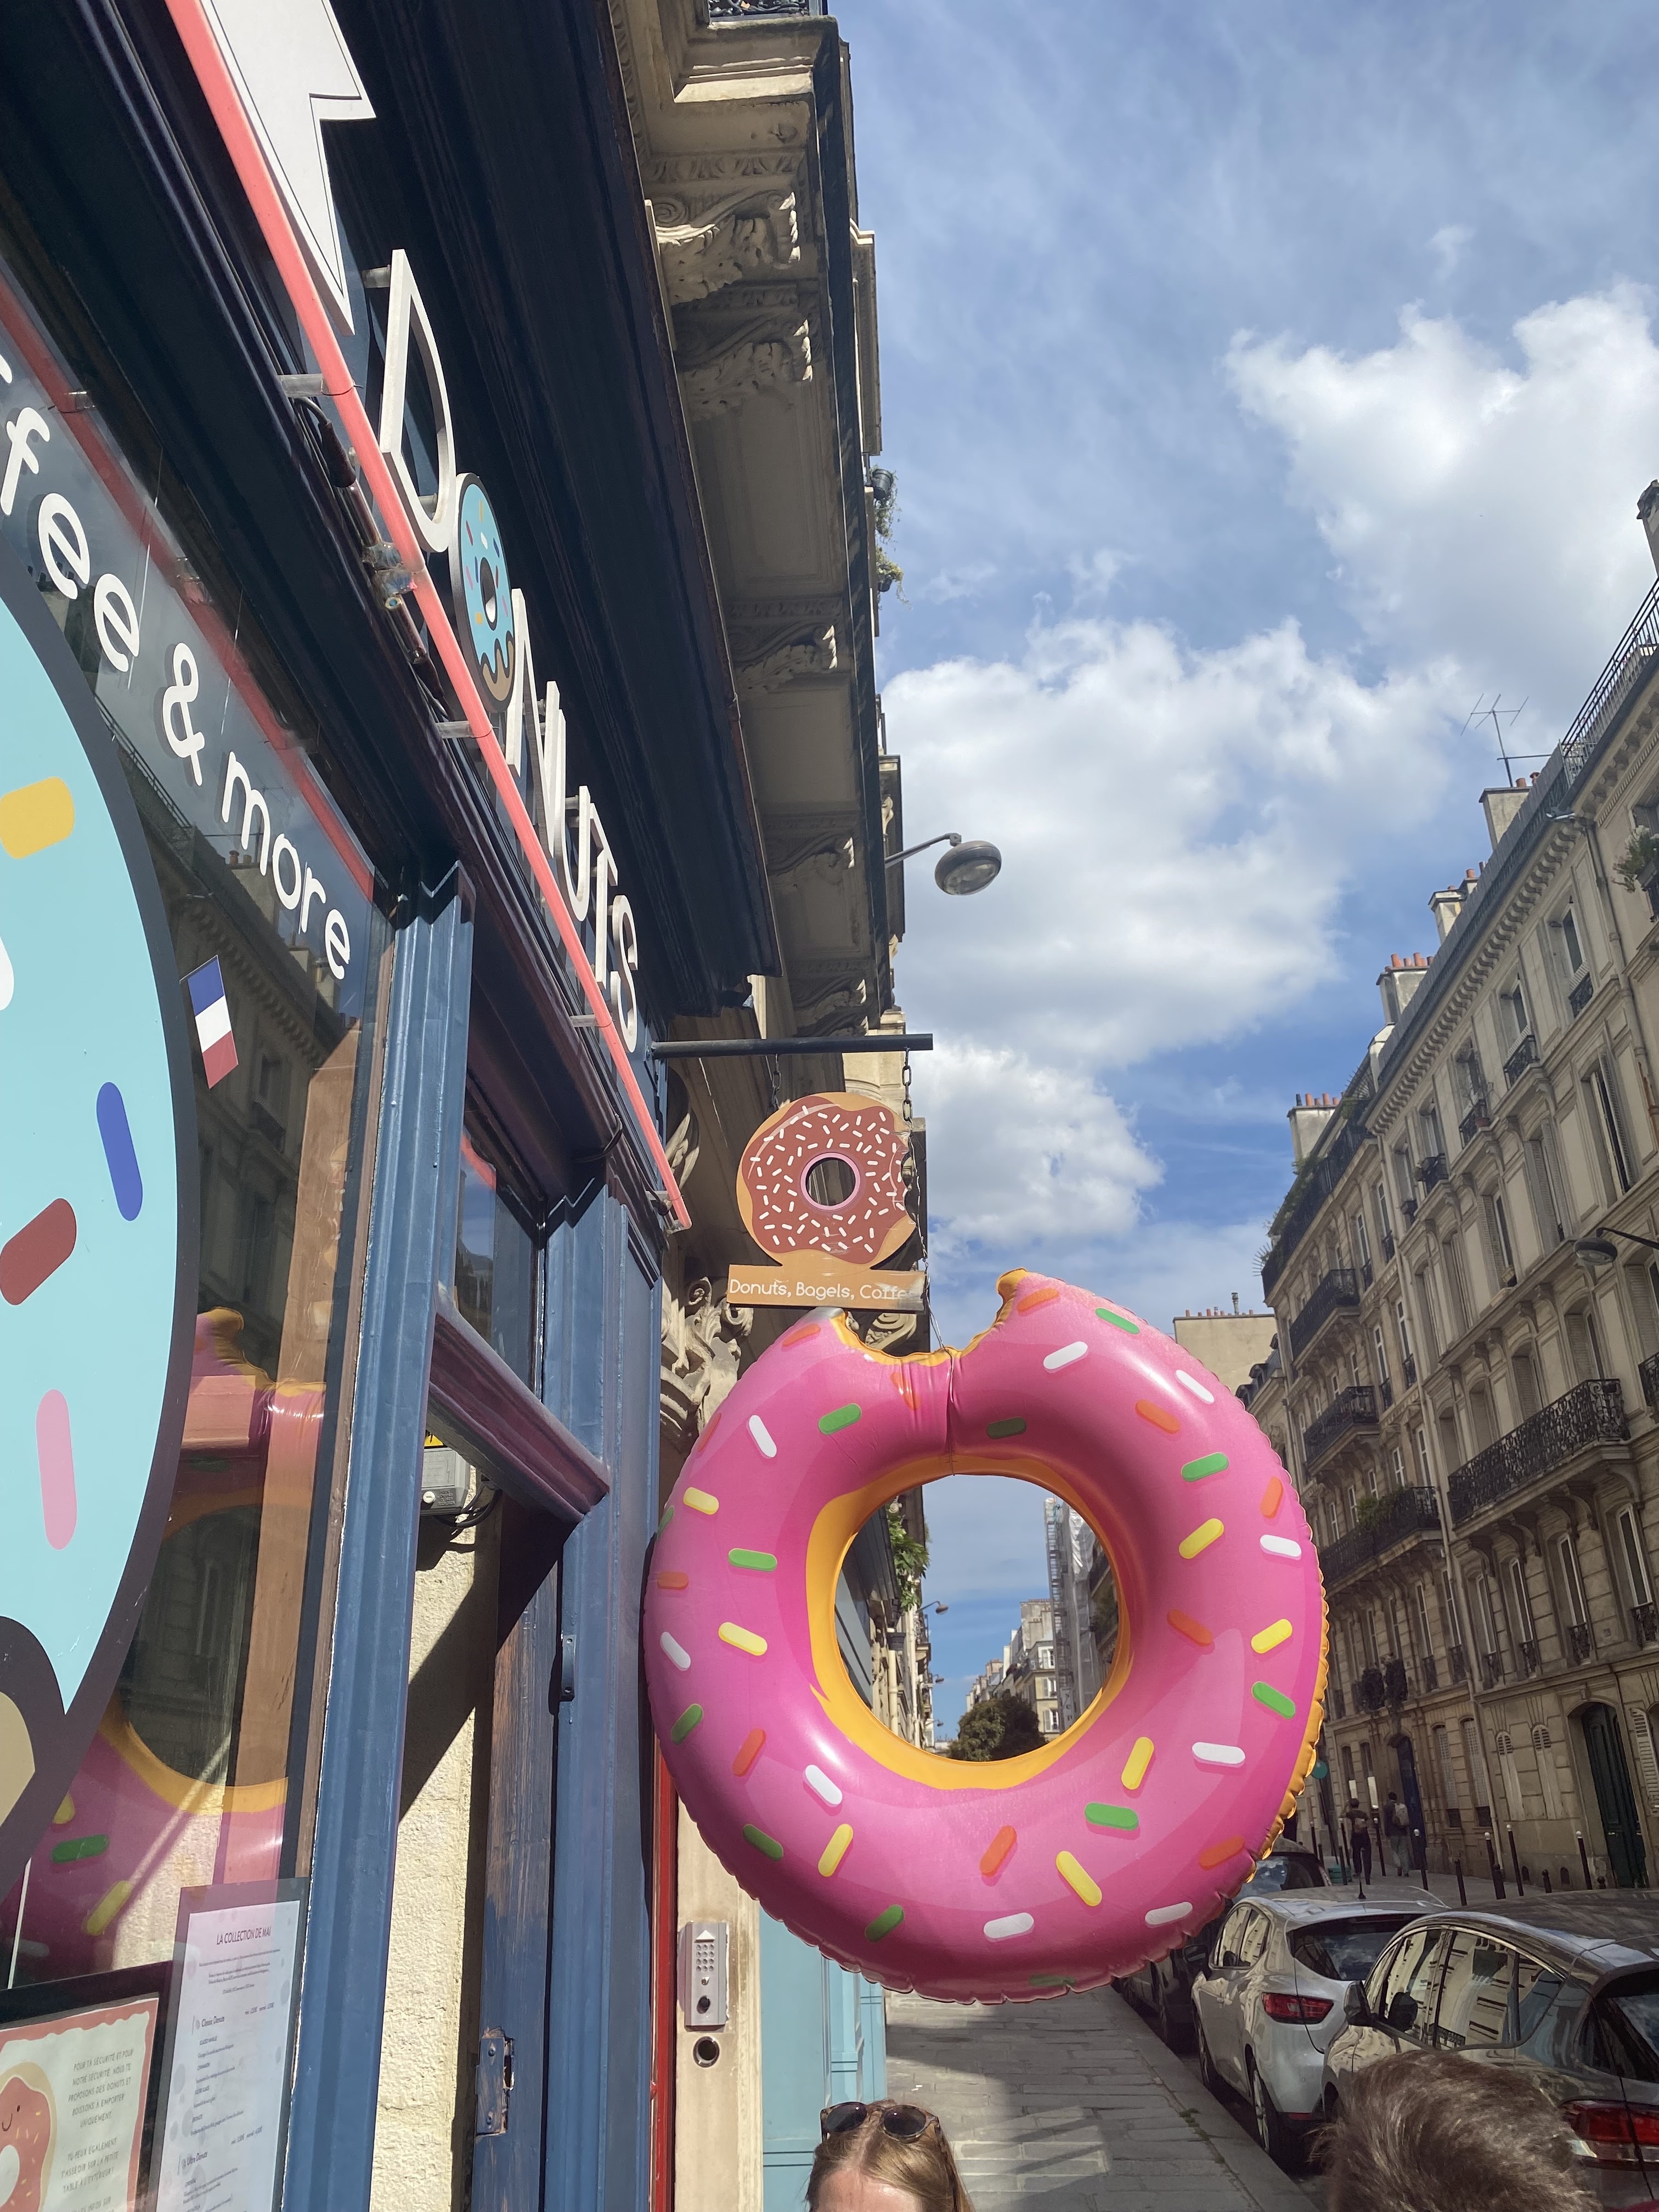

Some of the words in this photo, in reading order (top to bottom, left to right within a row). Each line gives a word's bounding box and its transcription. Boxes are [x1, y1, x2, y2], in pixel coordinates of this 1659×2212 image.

[162, 642, 206, 786] &
[222, 750, 350, 980] more
[729, 1279, 792, 1298] Donuts,
[795, 1282, 855, 1301] Bagels,
[216, 1934, 223, 1945] LA
[224, 1929, 254, 1944] COLLECTION
[255, 1927, 262, 1938] DE
[262, 1926, 272, 1937] MAI
[74, 2061, 86, 2071] POUR
[68, 2087, 95, 2102] PROPOSONS
[95, 2084, 105, 2094] DES
[106, 2079, 125, 2091] DONUTS
[72, 2075, 87, 2086] NOTRE
[72, 2102, 95, 2116] BOISSONS
[100, 2093, 125, 2107] EMPORTER
